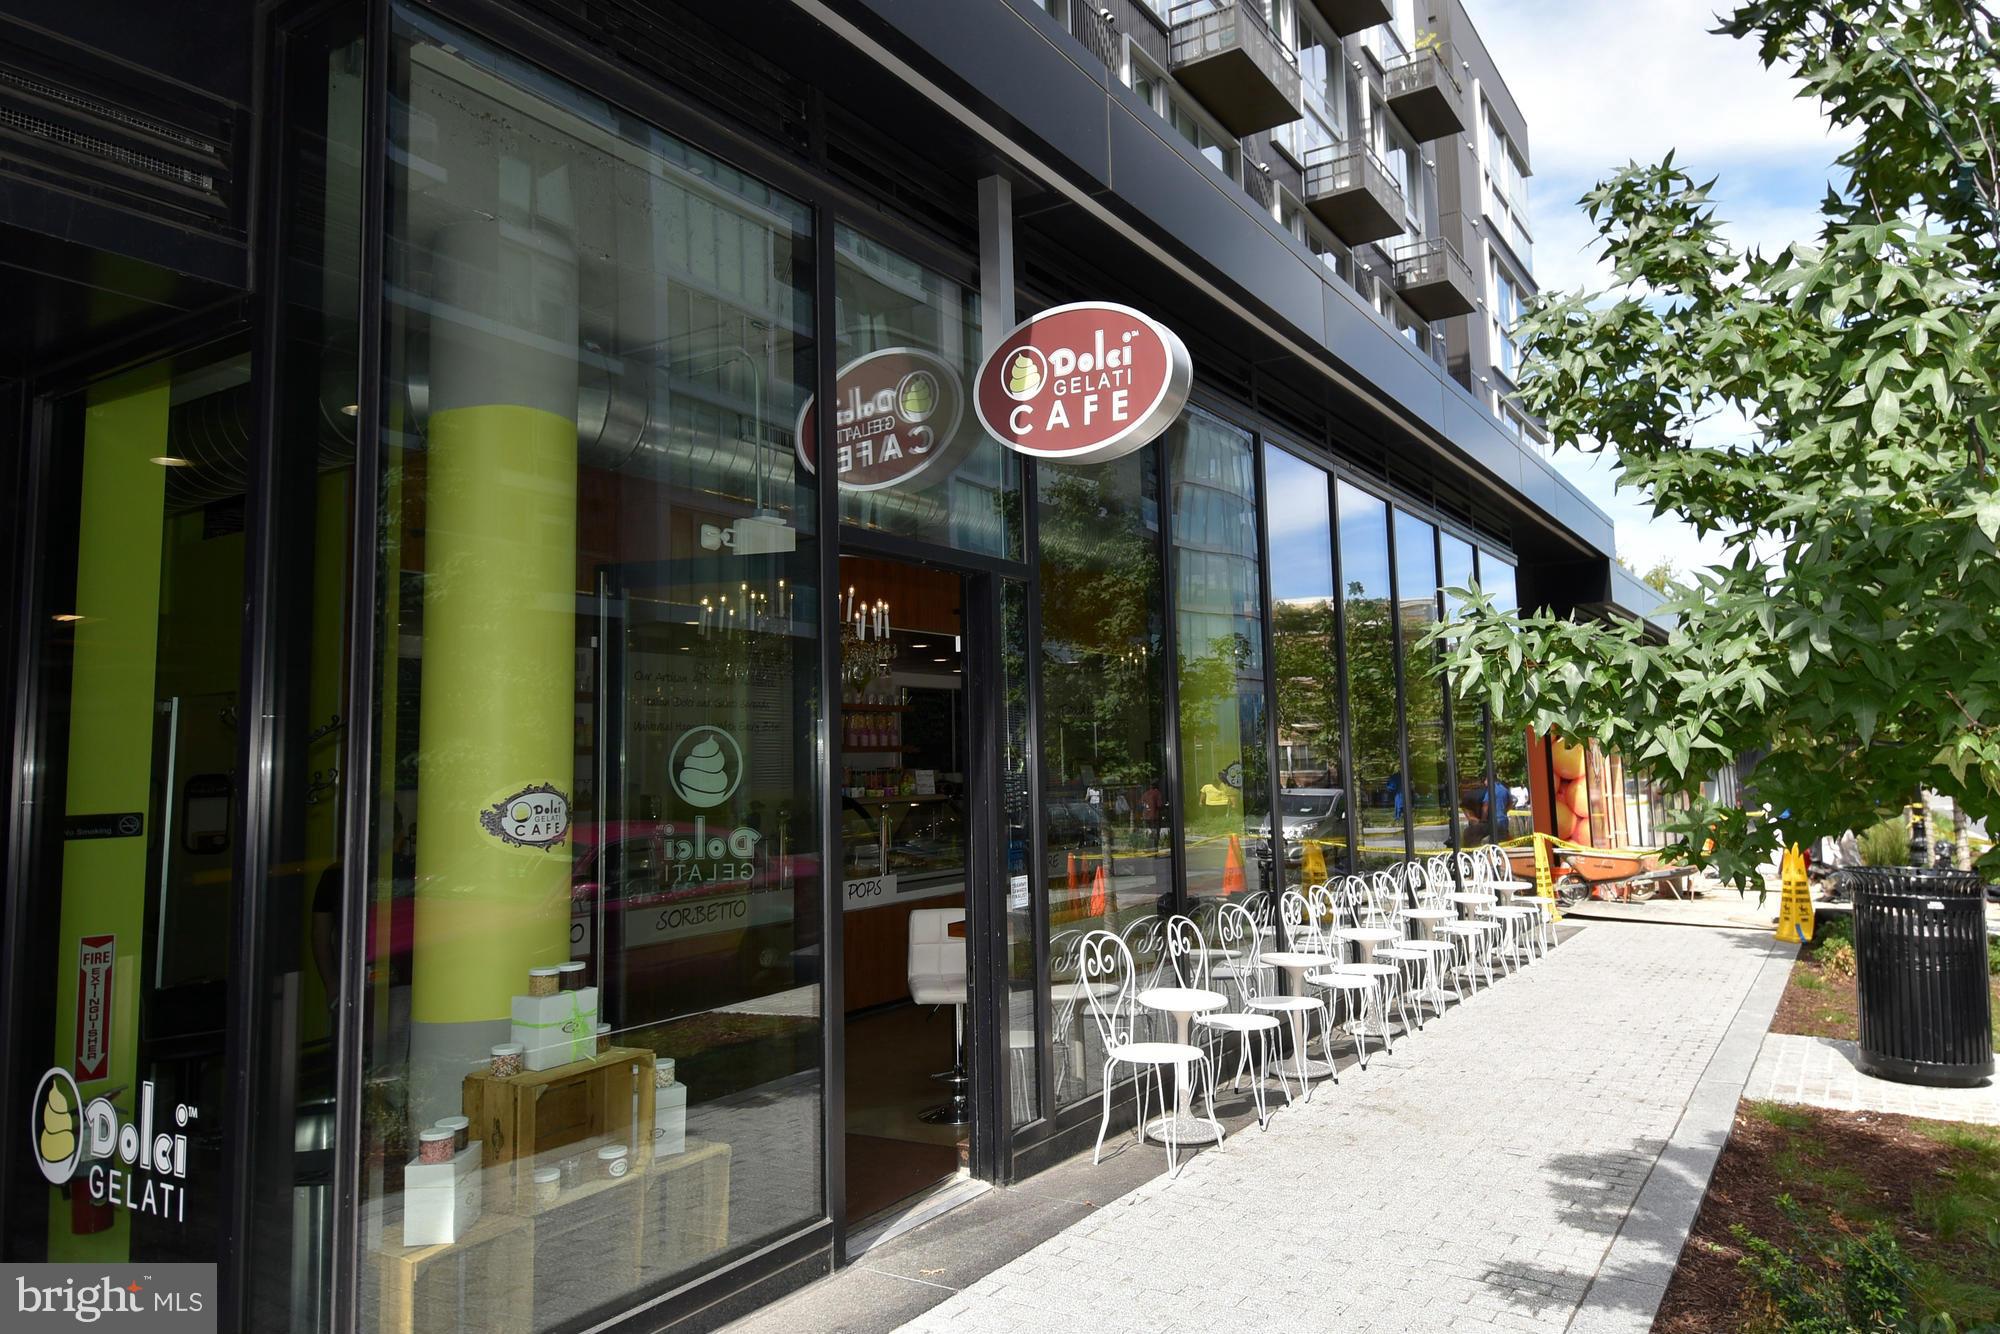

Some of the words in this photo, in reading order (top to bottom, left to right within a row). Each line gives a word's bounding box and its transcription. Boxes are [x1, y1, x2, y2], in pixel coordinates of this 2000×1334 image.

[1048, 330, 1132, 377] Dolci
[1053, 368, 1132, 396] GELATI
[1009, 389, 1129, 436] CAFE
[533, 800, 561, 815] Dolci
[534, 815, 560, 823] GELATI
[515, 822, 560, 837] CAFE
[848, 879, 882, 900] POPS
[656, 899, 747, 931] SORBETTO
[83, 951, 110, 966] FIRE
[87, 967, 101, 1060] EXTINGUISHER
[84, 1080, 188, 1179] Dolci
[89, 1164, 185, 1223] GELATI
